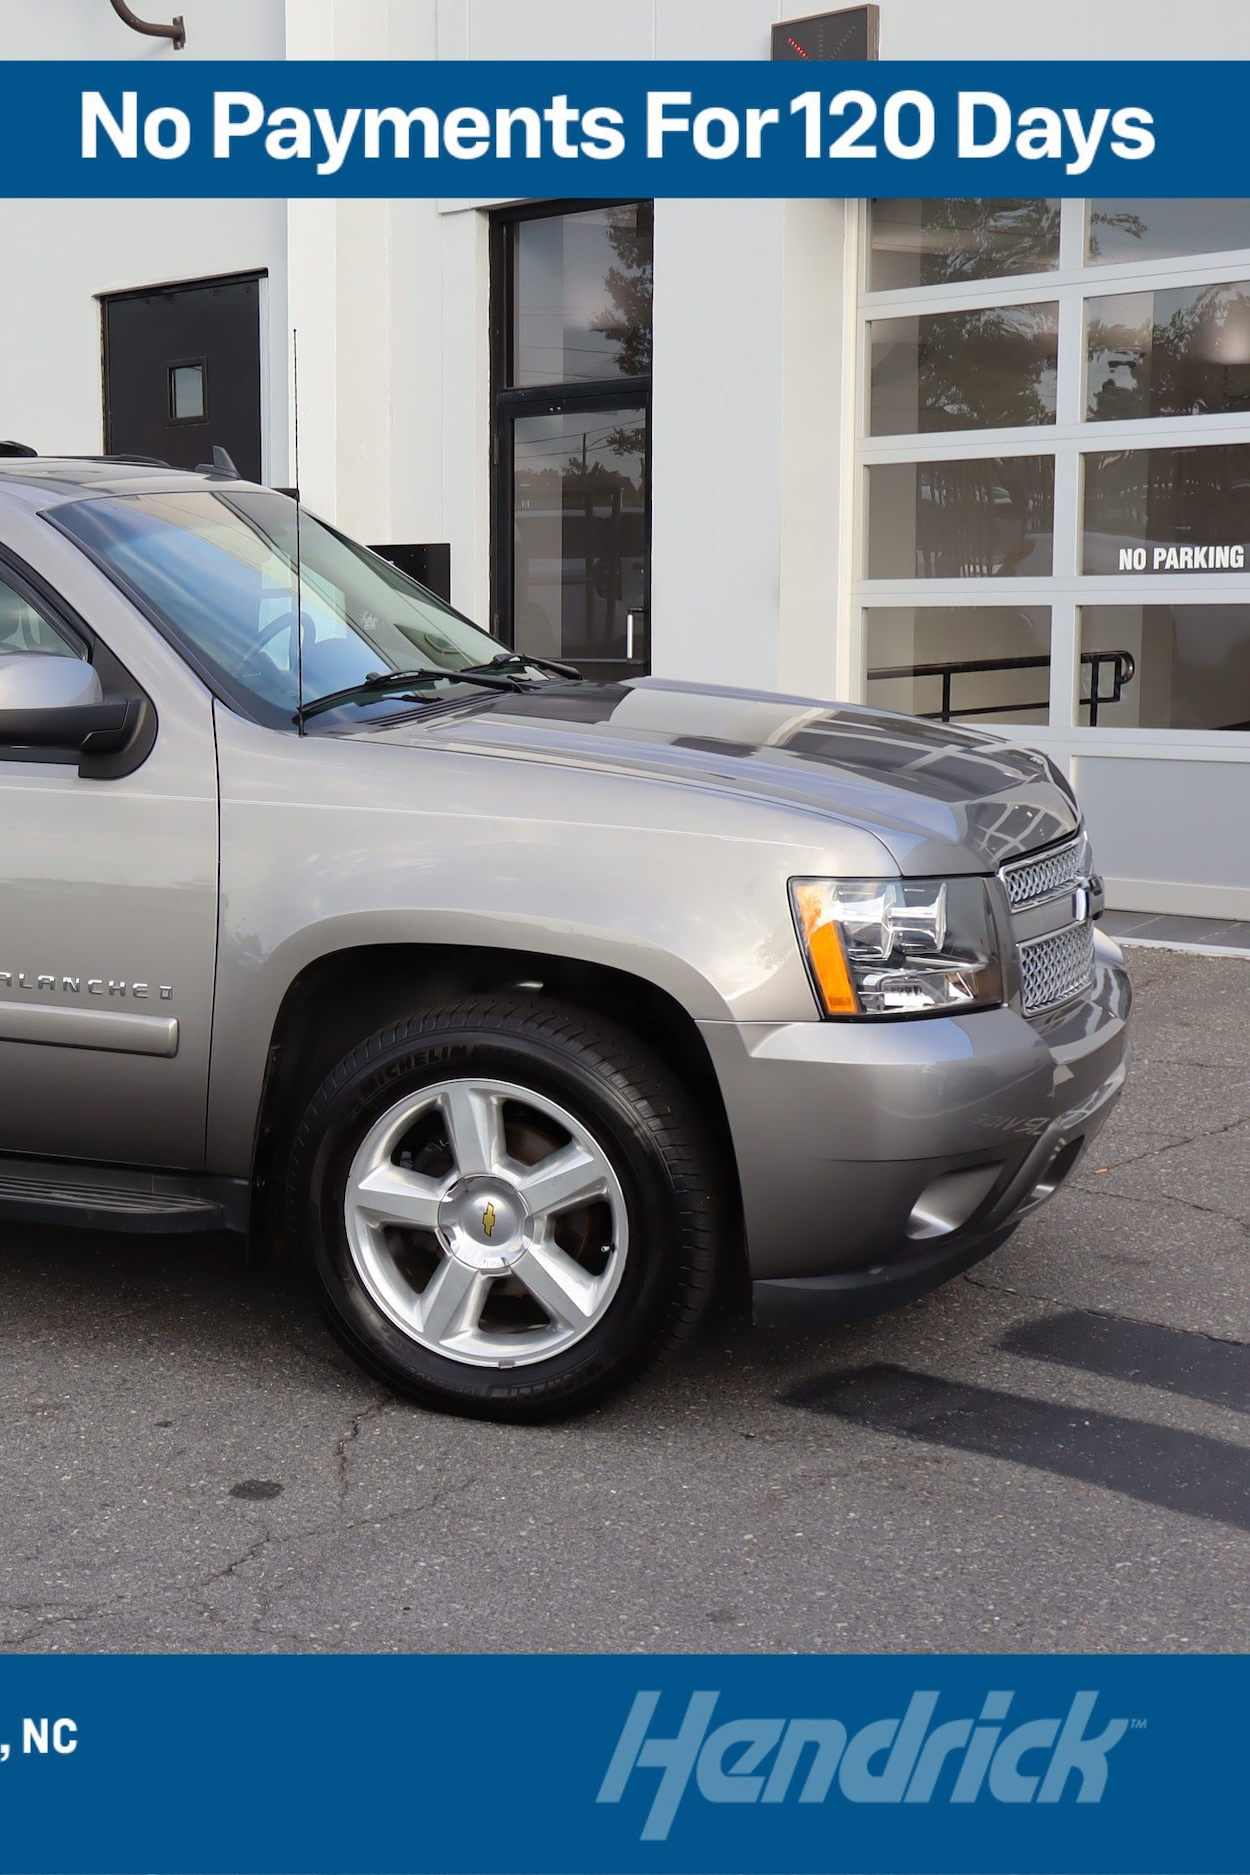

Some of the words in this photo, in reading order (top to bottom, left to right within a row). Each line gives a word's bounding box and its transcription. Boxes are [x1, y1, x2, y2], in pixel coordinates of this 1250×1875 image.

[1119, 547, 1147, 571] NO
[1153, 545, 1244, 570] PARKING
[359, 1044, 468, 1098] MICHELIN
